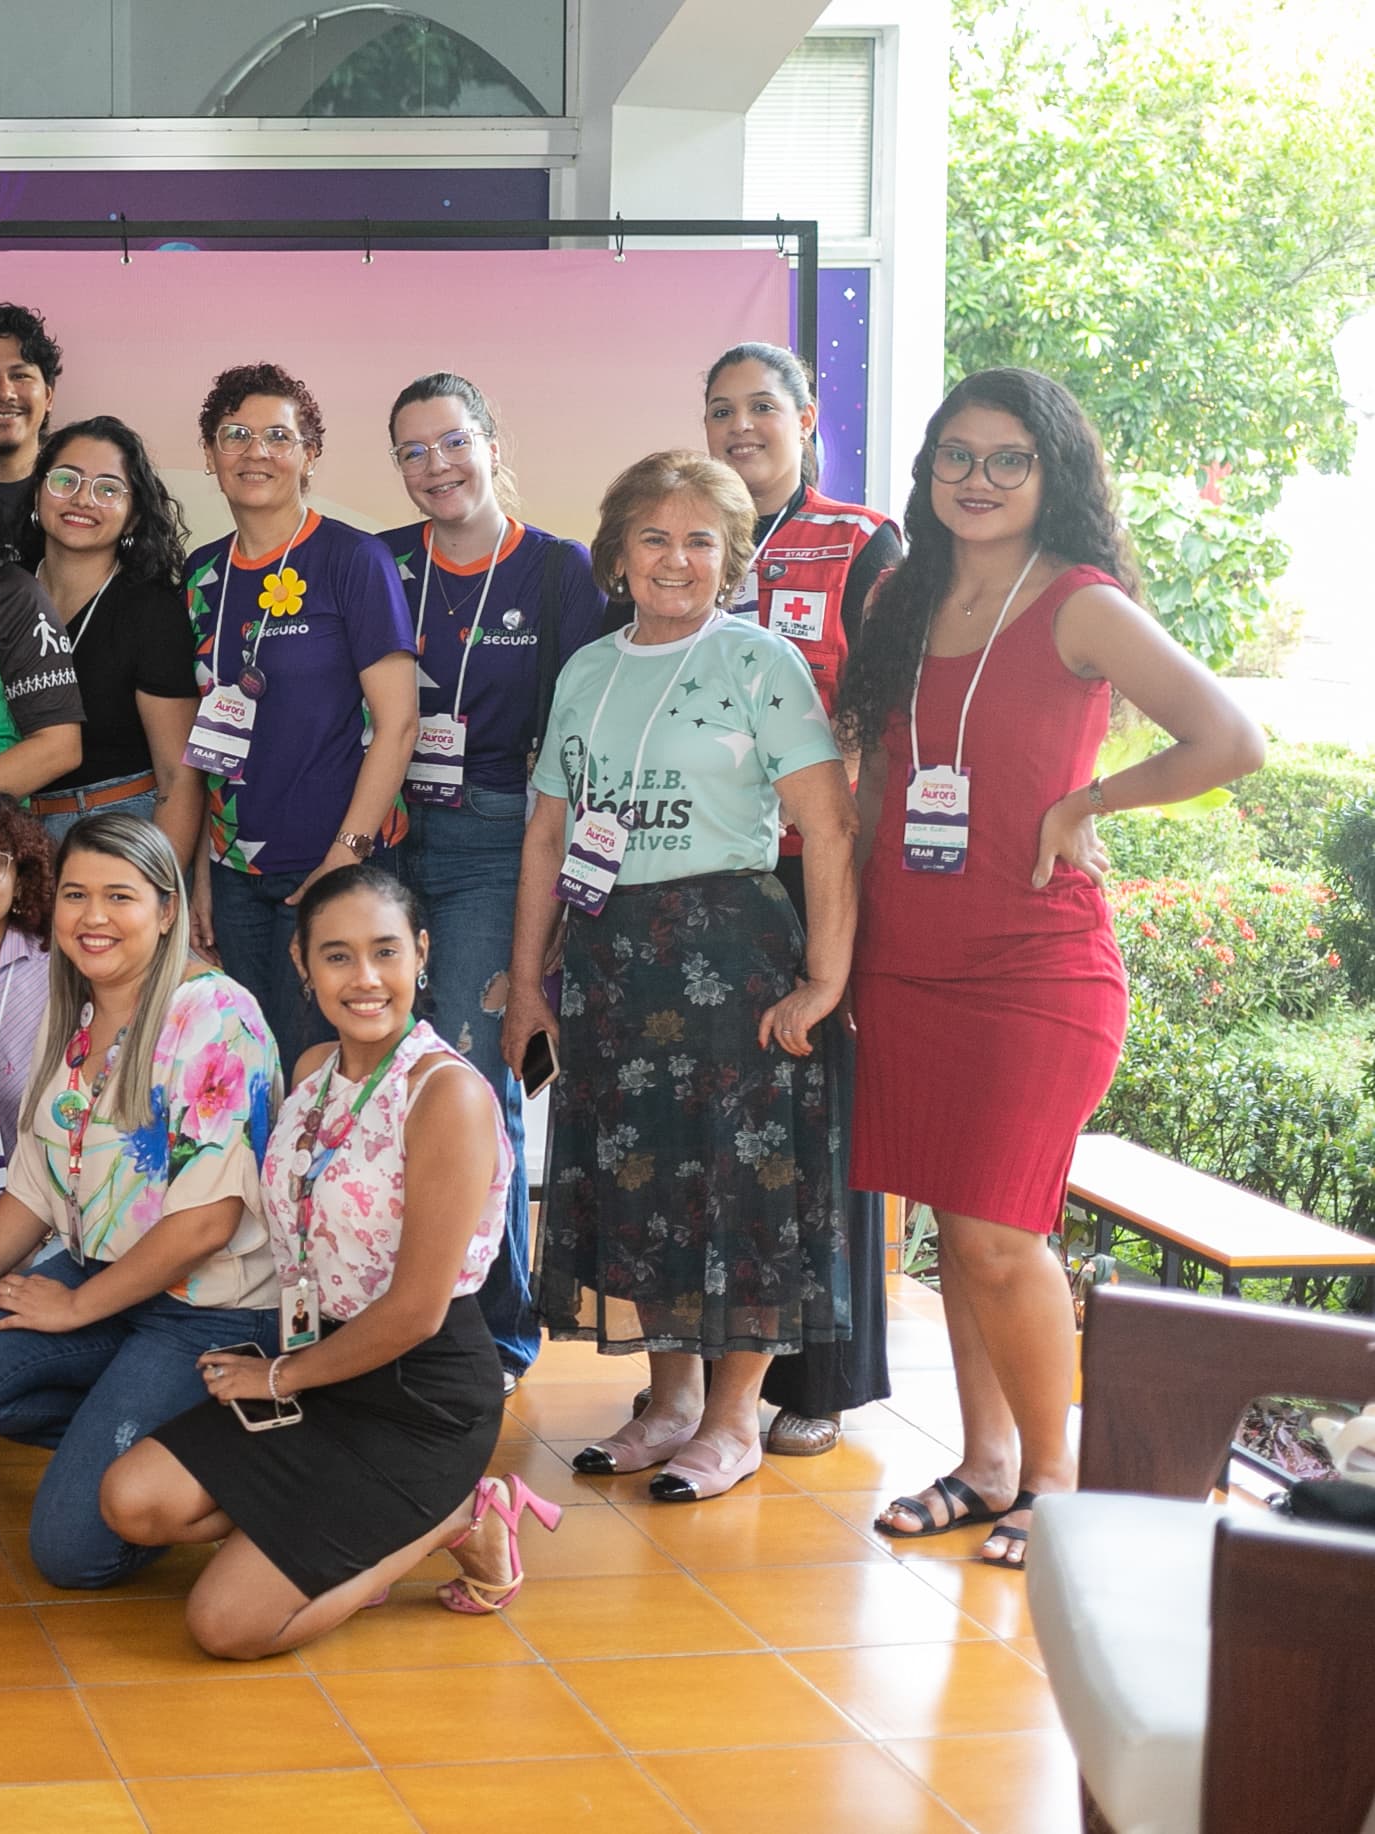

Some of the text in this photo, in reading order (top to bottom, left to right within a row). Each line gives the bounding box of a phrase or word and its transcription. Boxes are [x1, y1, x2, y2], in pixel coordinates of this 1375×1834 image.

[260, 624, 310, 639] SEGURO
[482, 635, 538, 646] SEGURO
[214, 700, 246, 716] Aurora
[421, 732, 454, 744] Aurora
[192, 748, 216, 760] FRAM
[618, 769, 687, 790] A.E.B.
[412, 783, 433, 792] FRAM
[921, 787, 957, 801] Aurora
[585, 826, 615, 848] Aurora
[910, 847, 934, 857] FRAM
[562, 878, 583, 892] FRAM
